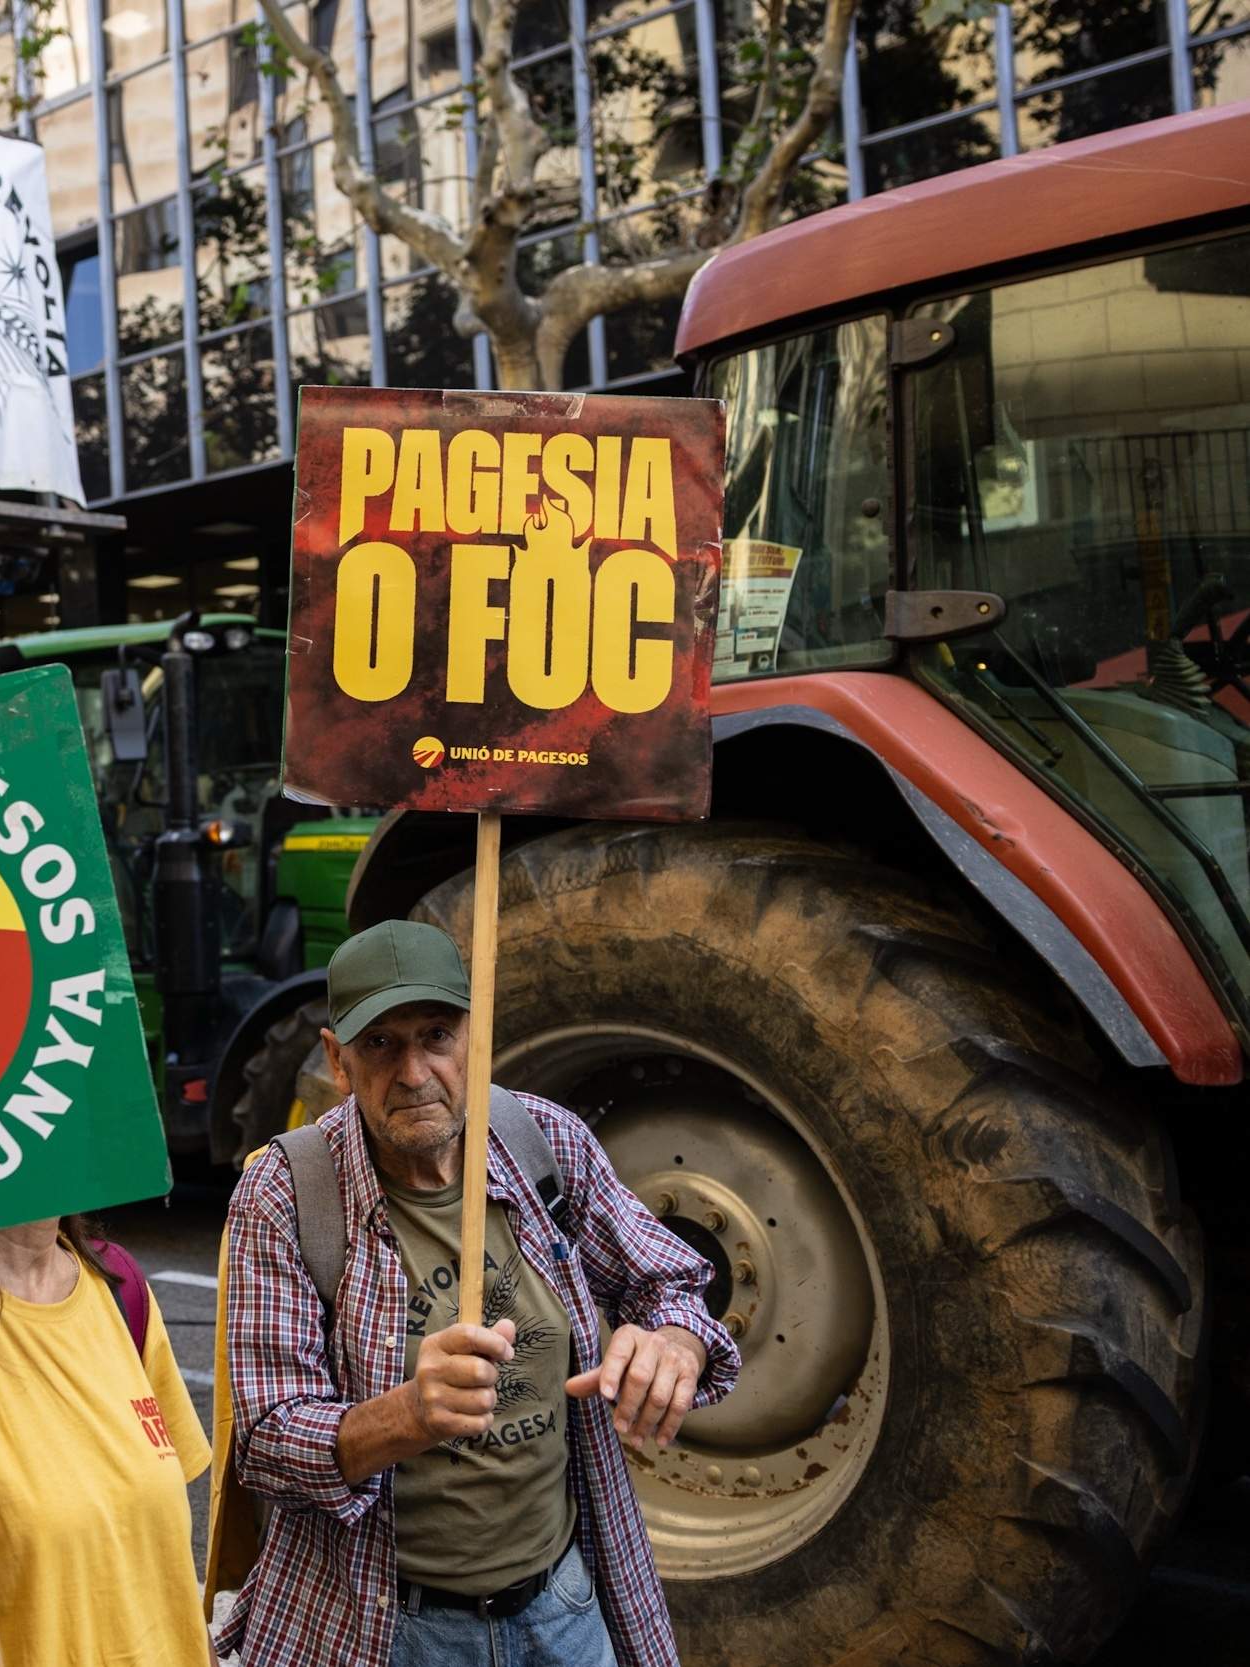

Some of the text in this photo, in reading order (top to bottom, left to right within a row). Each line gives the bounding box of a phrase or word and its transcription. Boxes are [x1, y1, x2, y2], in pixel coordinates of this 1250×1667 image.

[339, 427, 678, 560] PAGESIA
[333, 541, 676, 714] O FOC
[450, 746, 589, 766] UNIÓ DE PAGESOS
[407, 1250, 499, 1336] REVOA
[130, 1396, 160, 1420] PAGE
